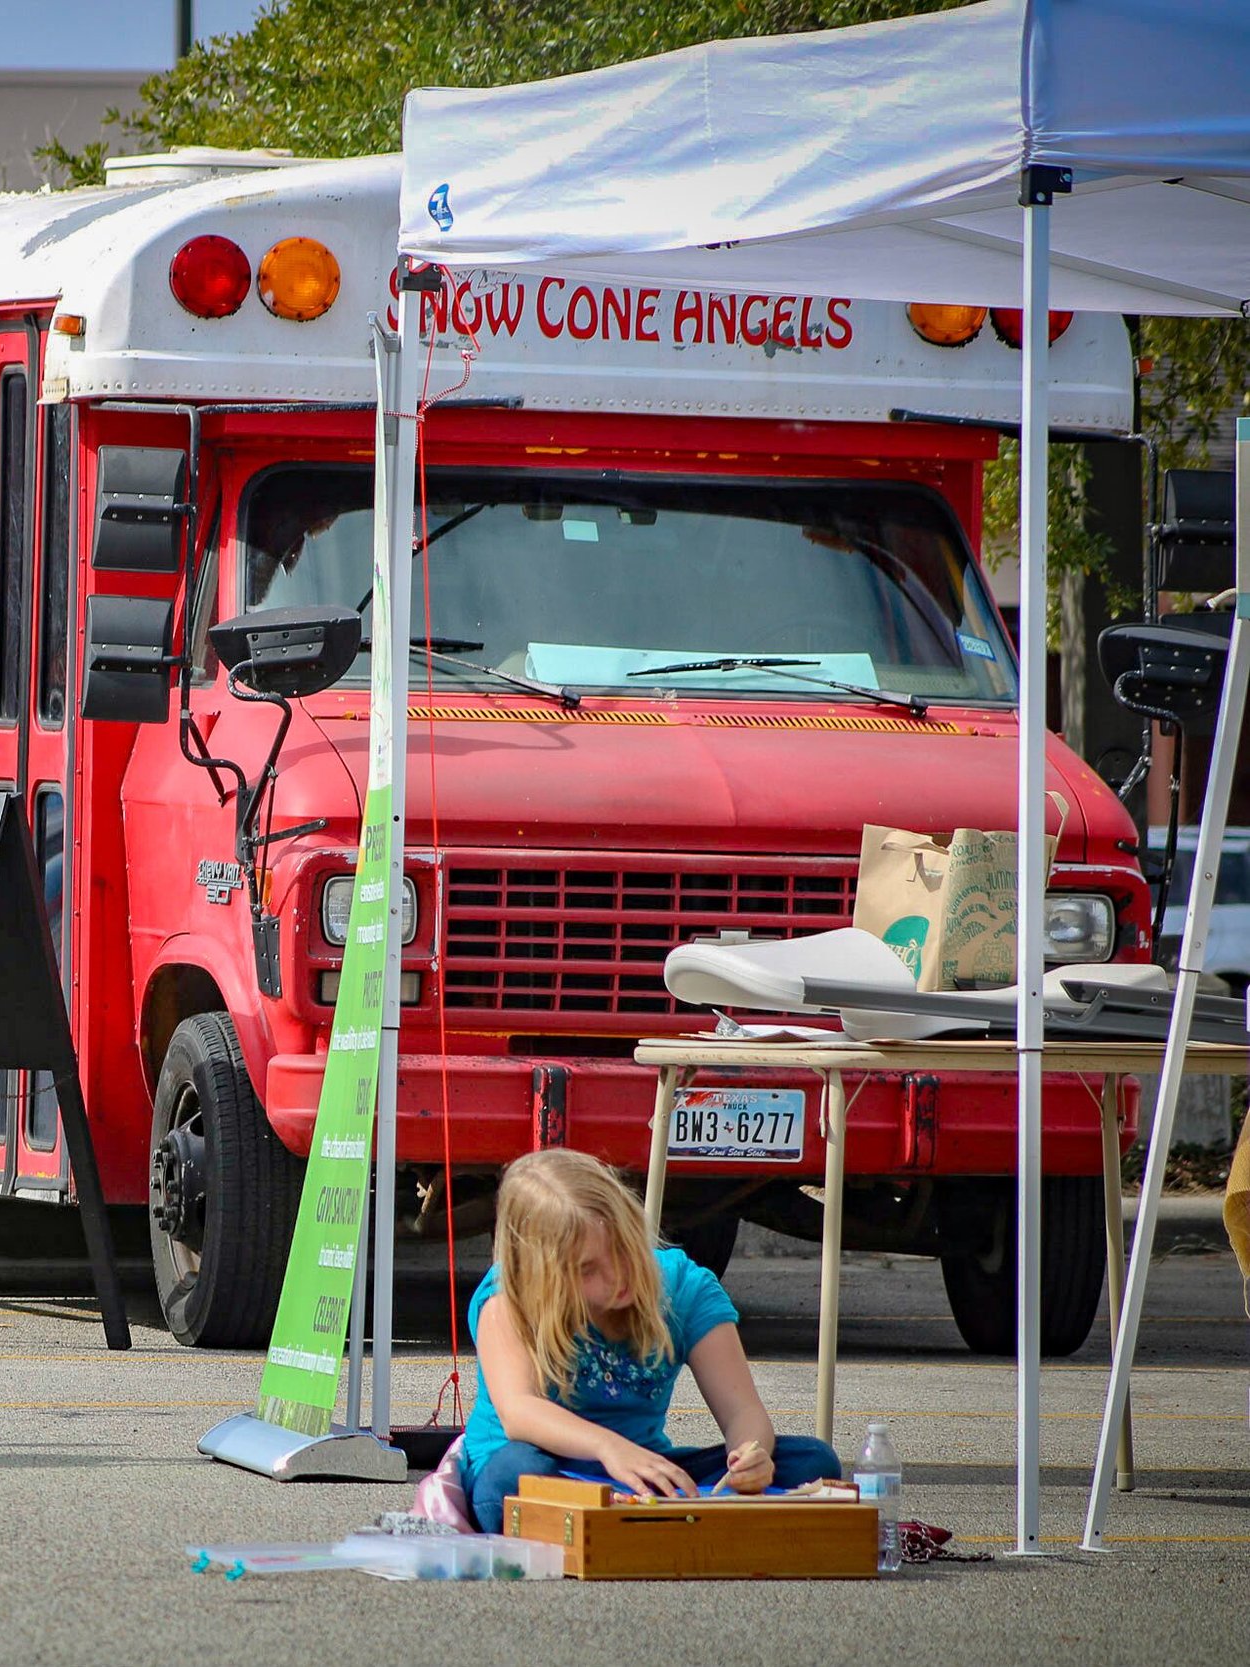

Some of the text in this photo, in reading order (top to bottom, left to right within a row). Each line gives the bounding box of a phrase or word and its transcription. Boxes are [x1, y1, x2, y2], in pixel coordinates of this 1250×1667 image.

[536, 276, 660, 342] CONE
[673, 290, 853, 349] ANGELS
[712, 1093, 758, 1103] TEXAS
[737, 1112, 795, 1144] 6277
[727, 1148, 744, 1157] Star
